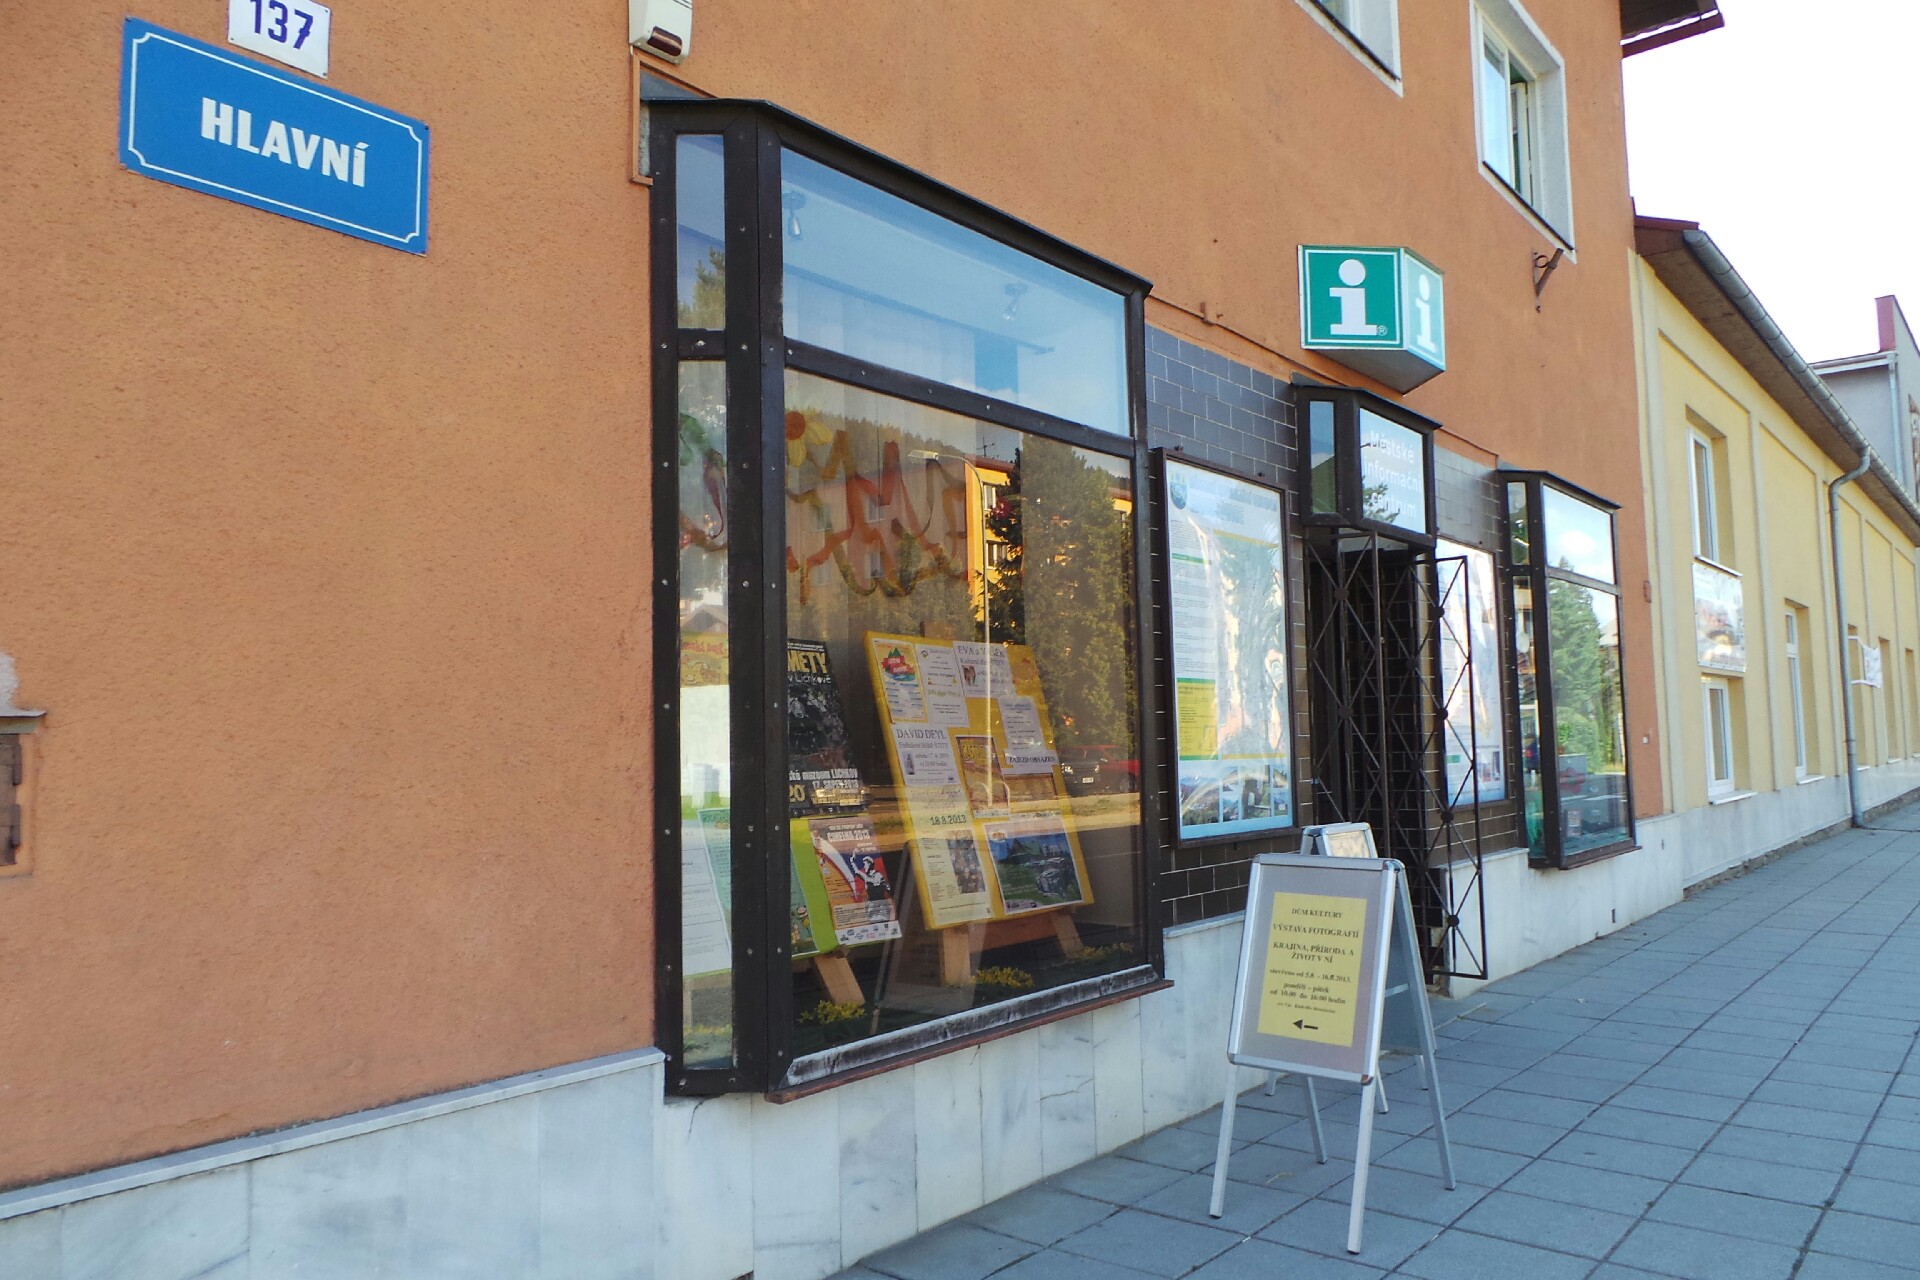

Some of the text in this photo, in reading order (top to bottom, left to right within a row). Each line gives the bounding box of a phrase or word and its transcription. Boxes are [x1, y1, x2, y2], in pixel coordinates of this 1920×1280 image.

[250, 0, 314, 50] 137
[201, 97, 369, 187] HLAVNÍ
[1370, 430, 1414, 464] Městské
[1364, 456, 1423, 492] informační
[1371, 492, 1417, 518] centrum
[896, 728, 924, 739] DAVID
[1309, 909, 1343, 918] KULTURY
[1272, 923, 1307, 934] VÝSTAVA
[1291, 952, 1316, 960] ŽIVOT
[1310, 944, 1346, 956] PŘÍRODA
